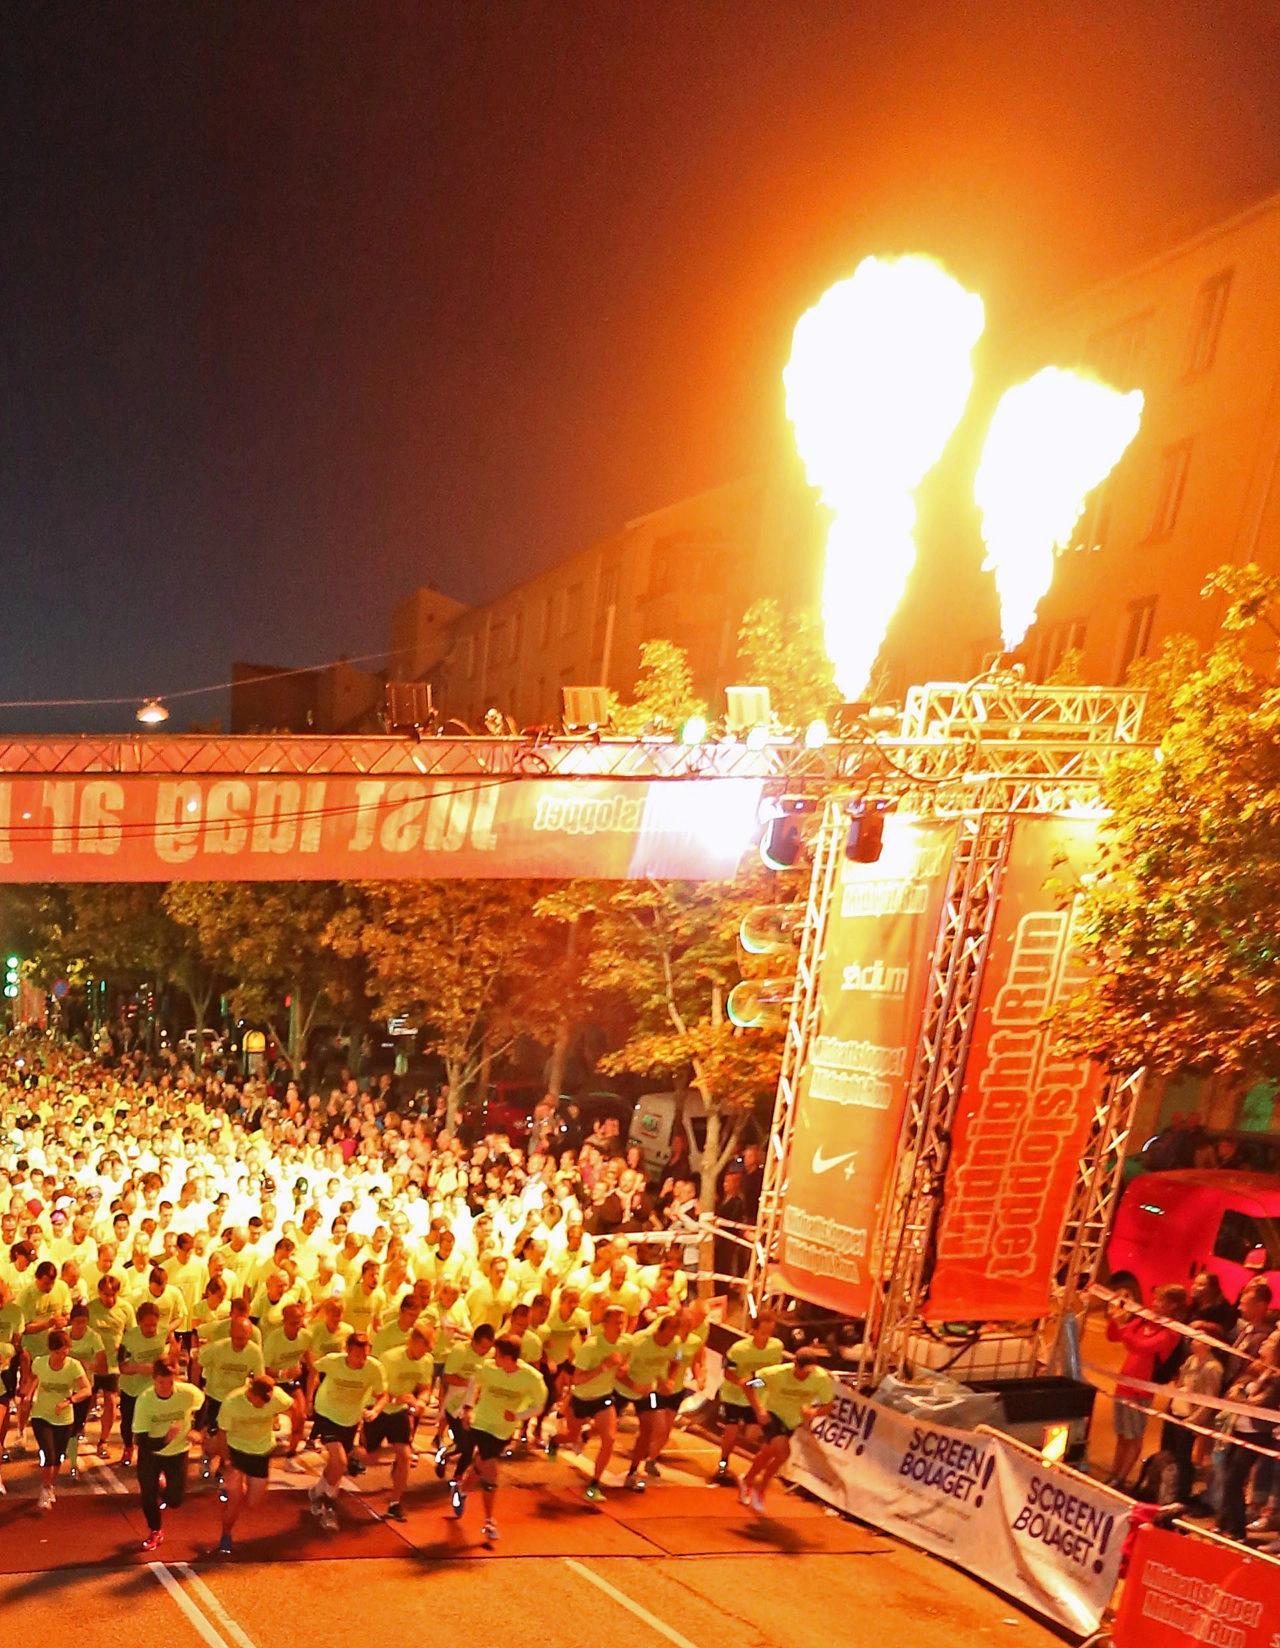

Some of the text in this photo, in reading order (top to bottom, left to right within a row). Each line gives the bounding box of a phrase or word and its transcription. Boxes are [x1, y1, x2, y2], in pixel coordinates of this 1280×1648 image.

[992, 911, 1068, 1026] Run
[910, 1427, 986, 1477] SCREEN
[1027, 1476, 1105, 1540] SCREEN
